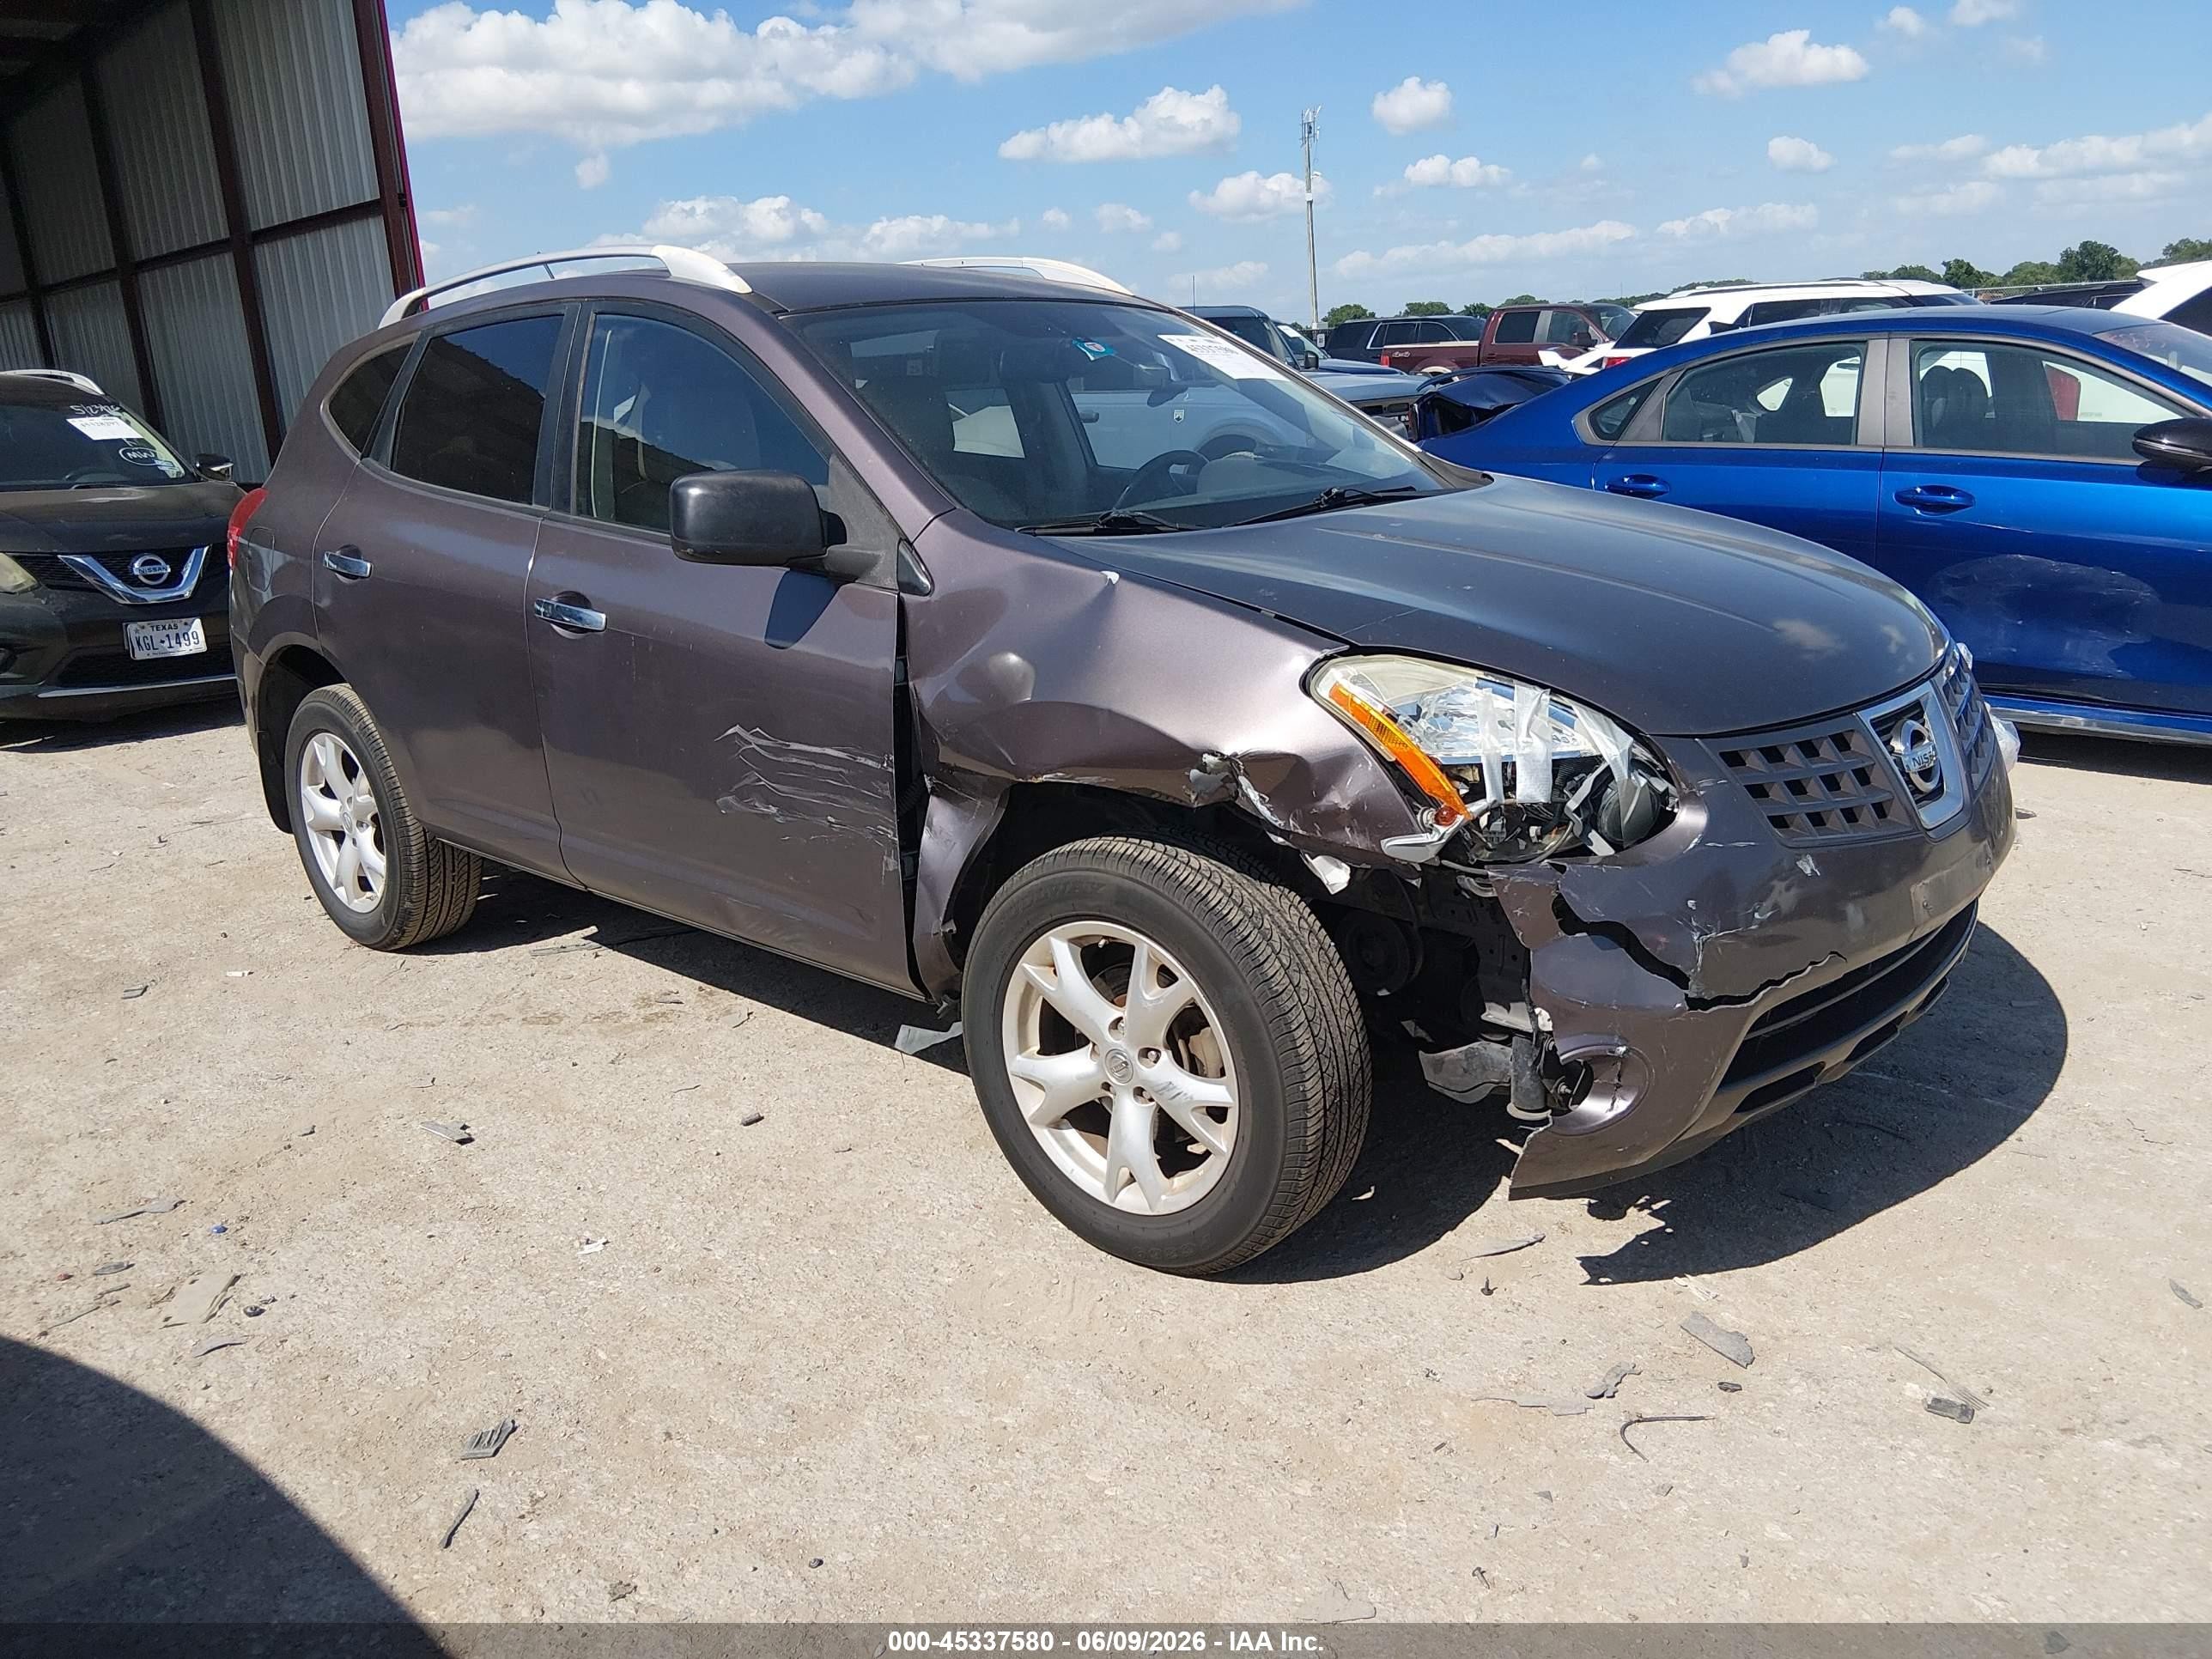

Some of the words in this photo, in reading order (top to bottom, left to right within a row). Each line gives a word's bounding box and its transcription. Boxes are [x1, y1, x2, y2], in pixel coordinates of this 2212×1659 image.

[150, 623, 179, 632] TEXAS
[135, 635, 159, 652] KGL
[165, 630, 200, 649] 1499
